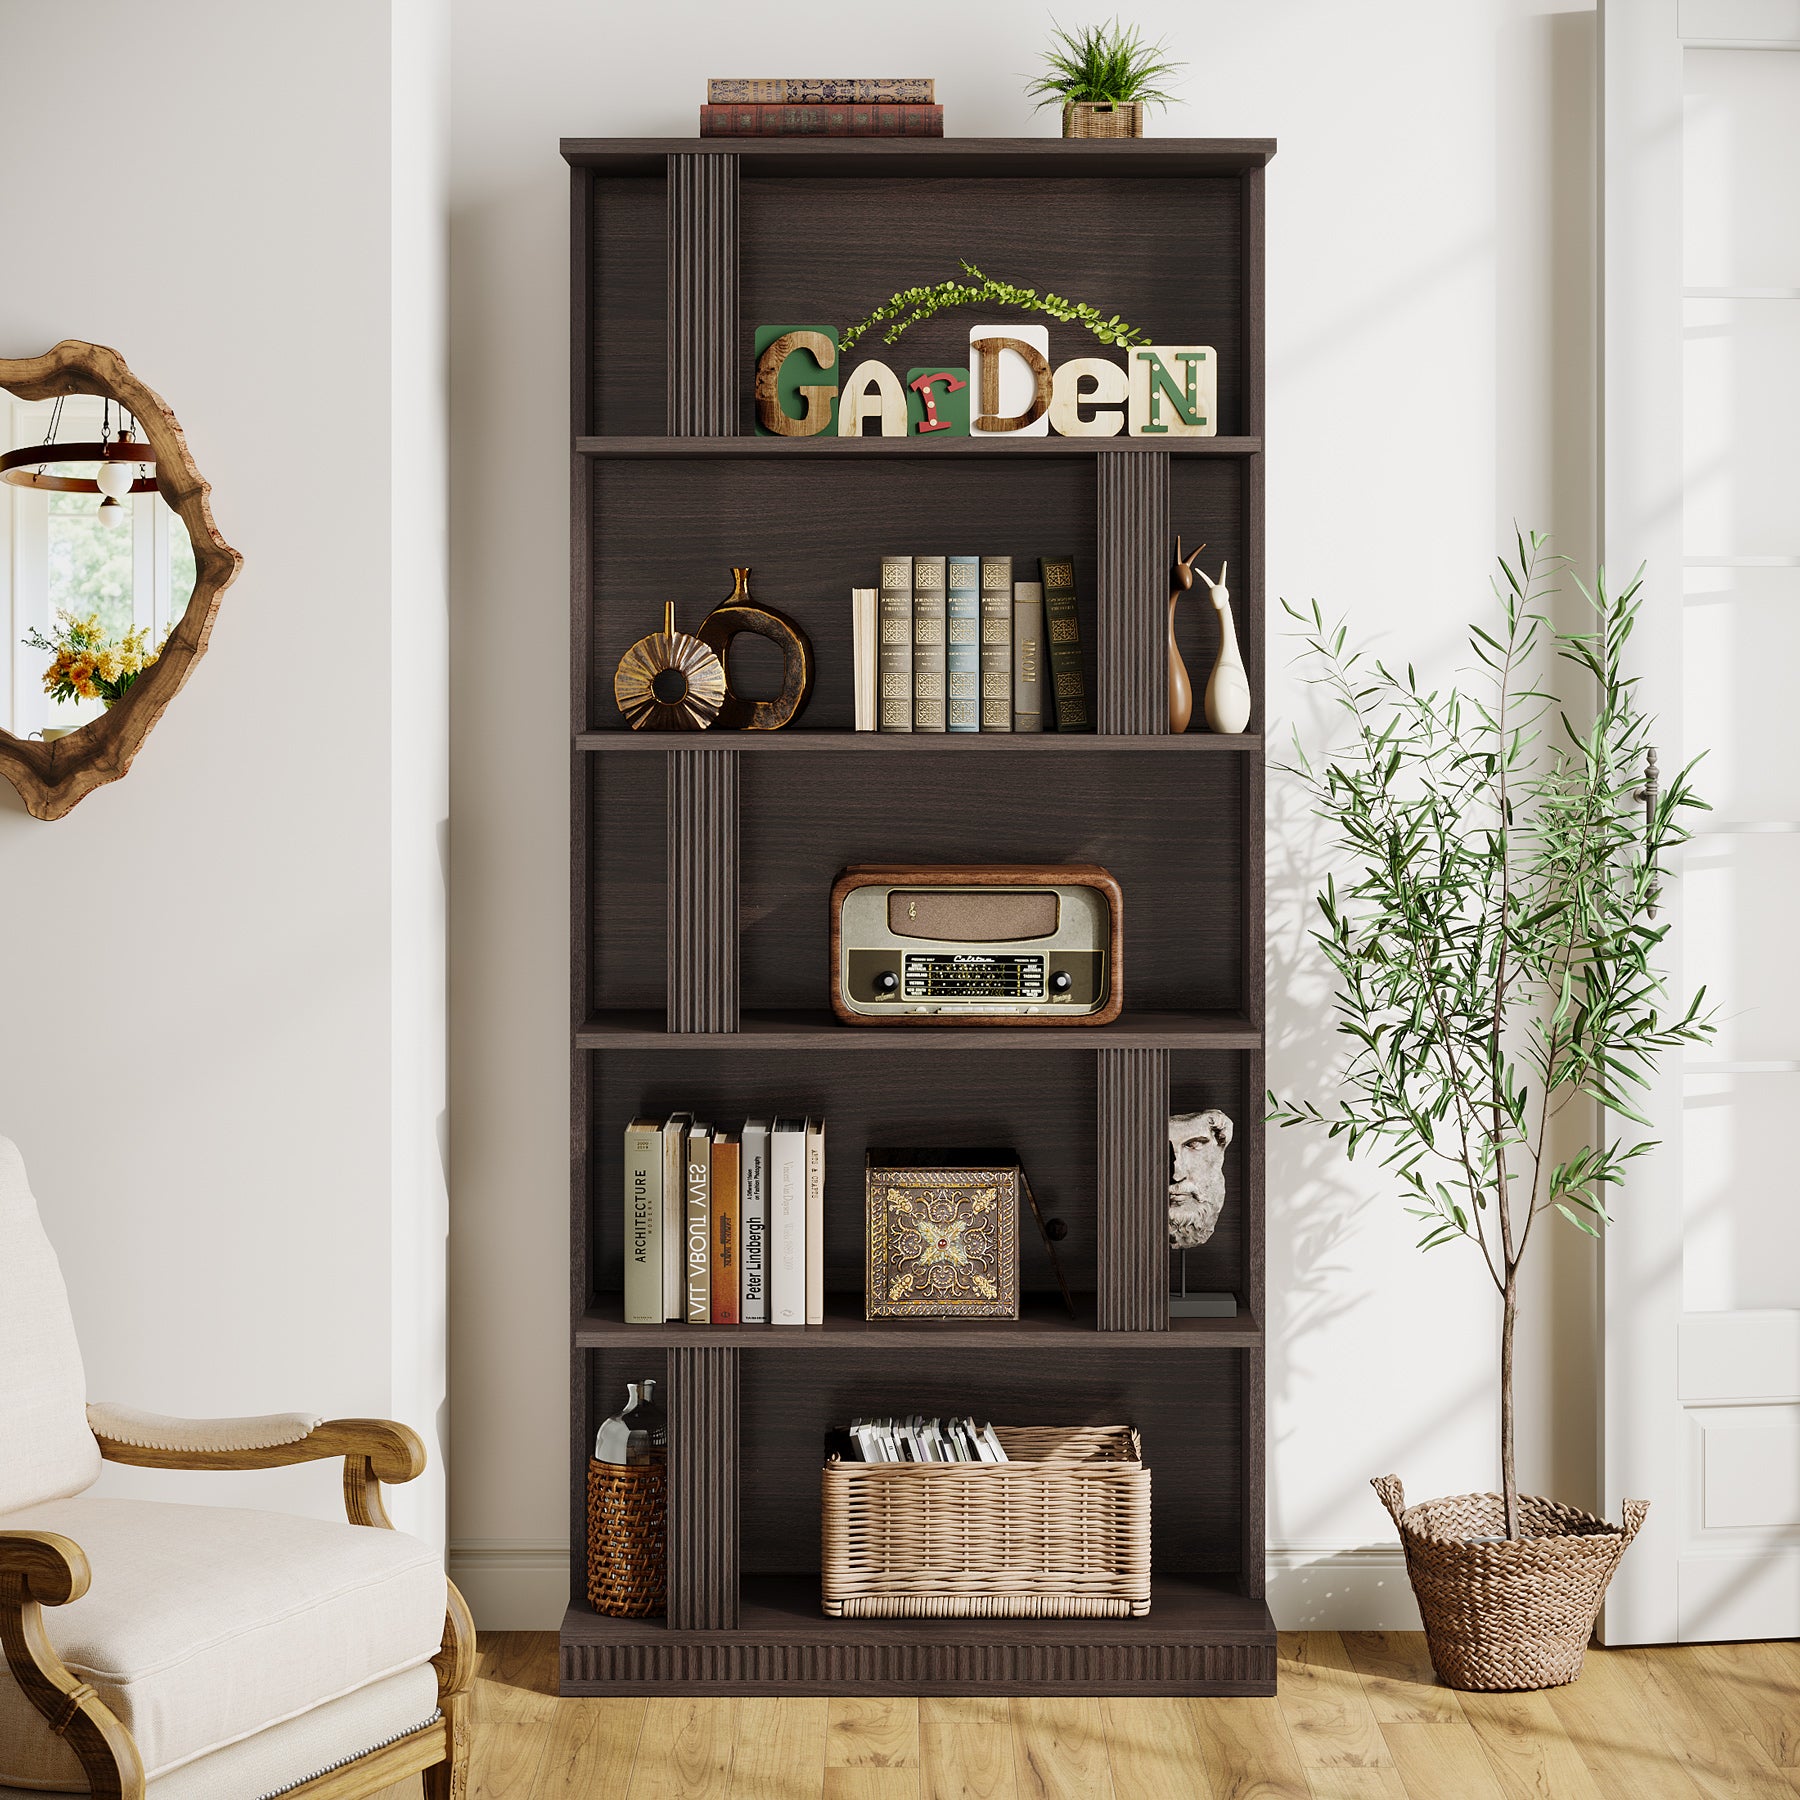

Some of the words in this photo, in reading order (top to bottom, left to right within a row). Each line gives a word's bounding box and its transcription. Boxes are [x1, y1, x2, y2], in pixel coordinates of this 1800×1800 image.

[1022, 638, 1036, 683] HOME
[754, 1156, 762, 1180] Photography
[783, 1160, 794, 1182] Vincent
[634, 1169, 646, 1263] ARCHITECTURE
[745, 1216, 765, 1271] Lindbergh
[745, 1273, 762, 1301] Peter
